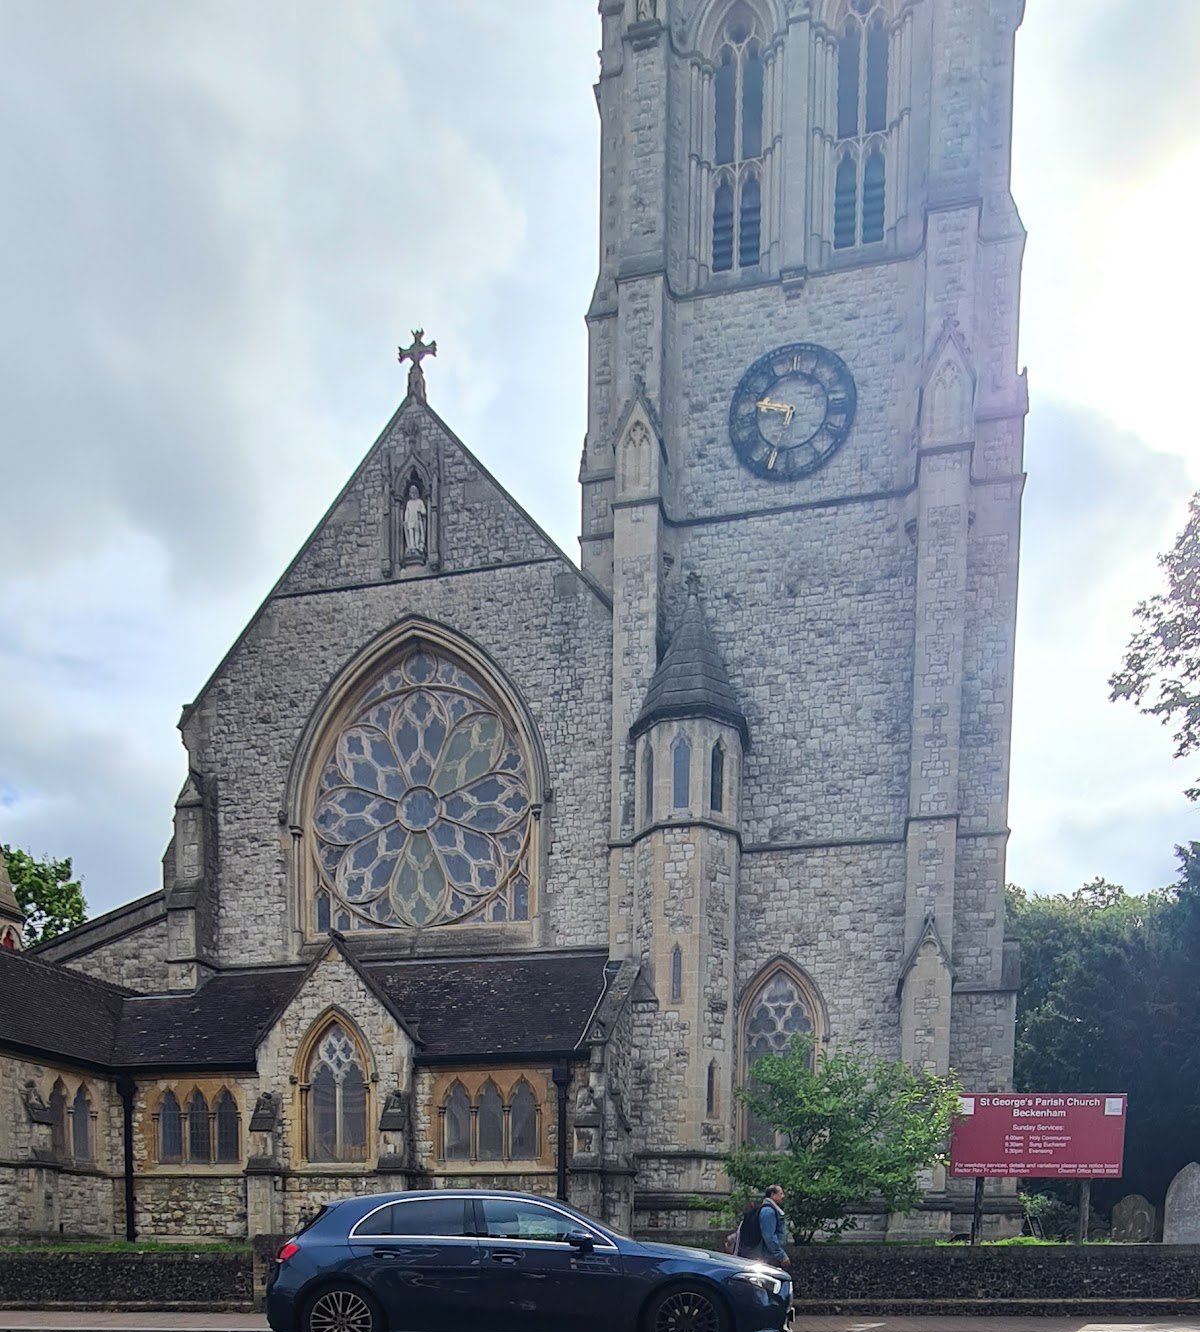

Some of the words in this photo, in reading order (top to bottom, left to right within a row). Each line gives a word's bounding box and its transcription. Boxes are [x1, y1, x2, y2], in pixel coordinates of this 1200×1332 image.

[980, 1098, 990, 1106] St
[992, 1098, 1033, 1108] George's
[1035, 1098, 1065, 1106] Parish
[1066, 1098, 1101, 1106] Church
[1012, 1109, 1067, 1117] Beckenham
[1012, 1124, 1036, 1132] Sunday
